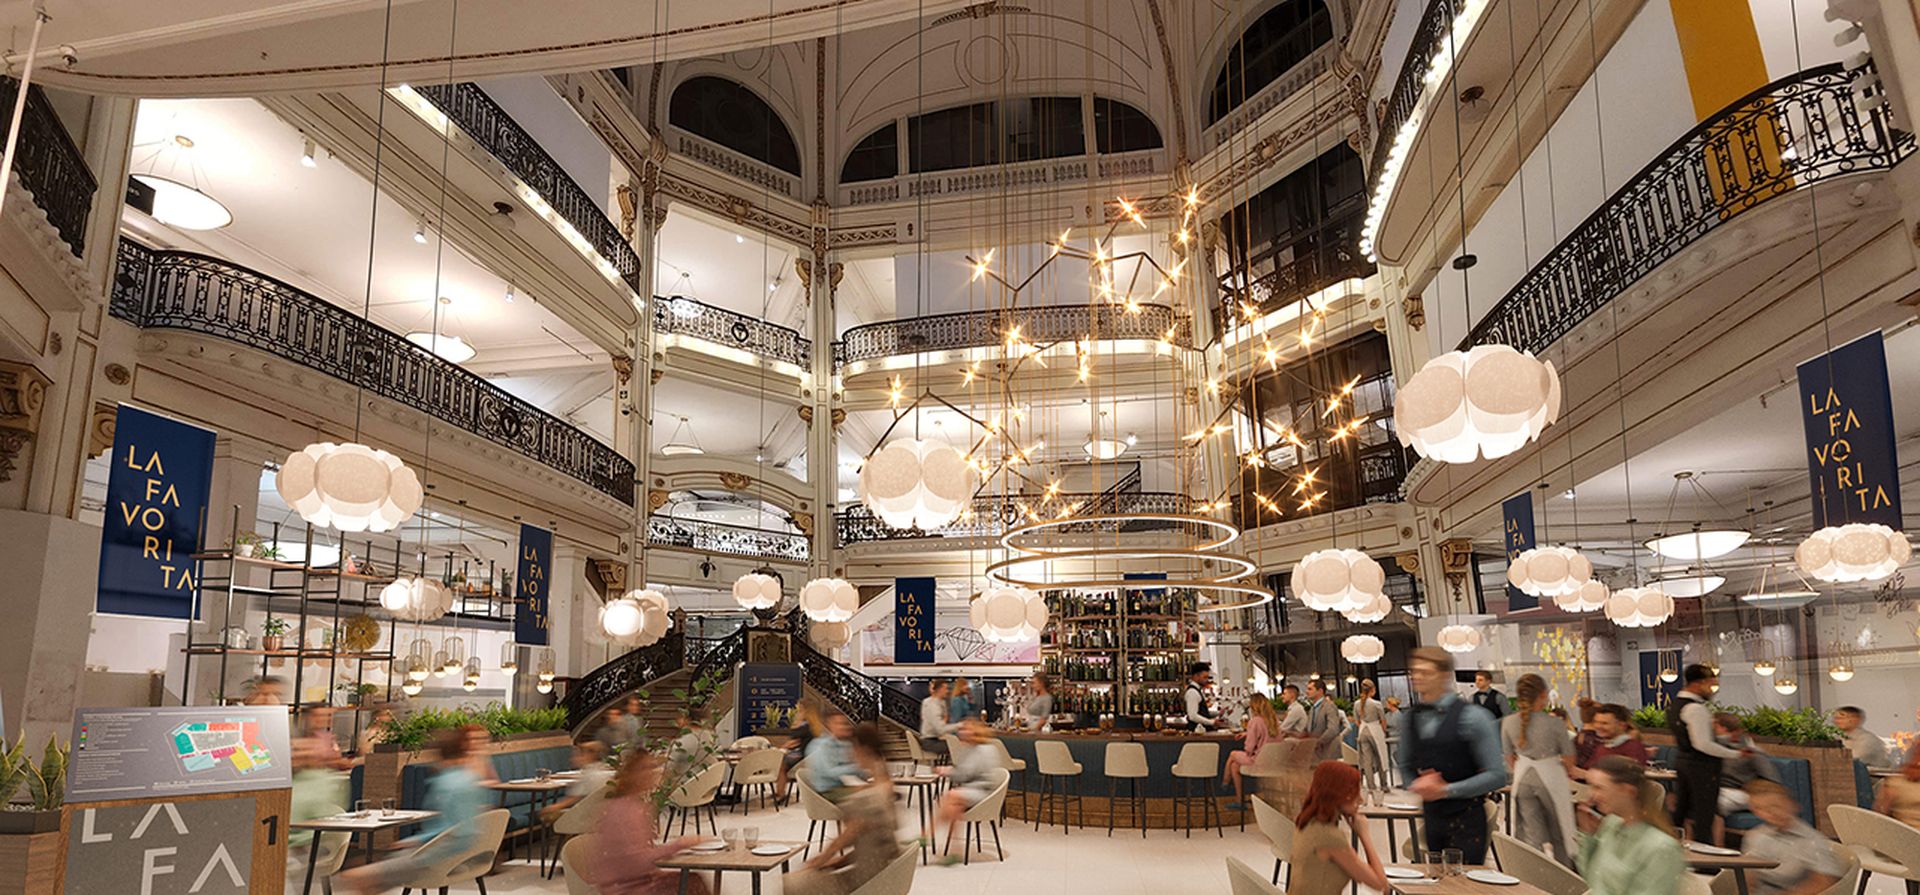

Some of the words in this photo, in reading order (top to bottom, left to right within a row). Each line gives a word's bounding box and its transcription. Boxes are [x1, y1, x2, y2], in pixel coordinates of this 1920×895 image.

[1810, 386, 1842, 416] LA
[1829, 408, 1861, 437] FA
[127, 444, 164, 476] LA
[1813, 439, 1851, 466] VO
[1836, 462, 1863, 490] RI
[145, 478, 180, 508] FA
[1855, 485, 1892, 512] TA
[120, 502, 165, 531] VO
[1506, 517, 1519, 533] LA
[143, 535, 173, 561] RI
[1513, 532, 1526, 547] FA
[524, 545, 538, 562] LA
[160, 565, 194, 591] TA
[530, 564, 543, 580] FA
[529, 597, 541, 612] RI
[900, 592, 915, 604] LA
[907, 604, 923, 615] FA
[535, 614, 549, 629] TA
[899, 616, 918, 627] VO
[908, 629, 922, 639] RI
[916, 640, 932, 652] TA
[1647, 674, 1663, 689] LA
[82, 803, 190, 843] LA
[261, 815, 279, 845] 1
[140, 842, 246, 895] FA
